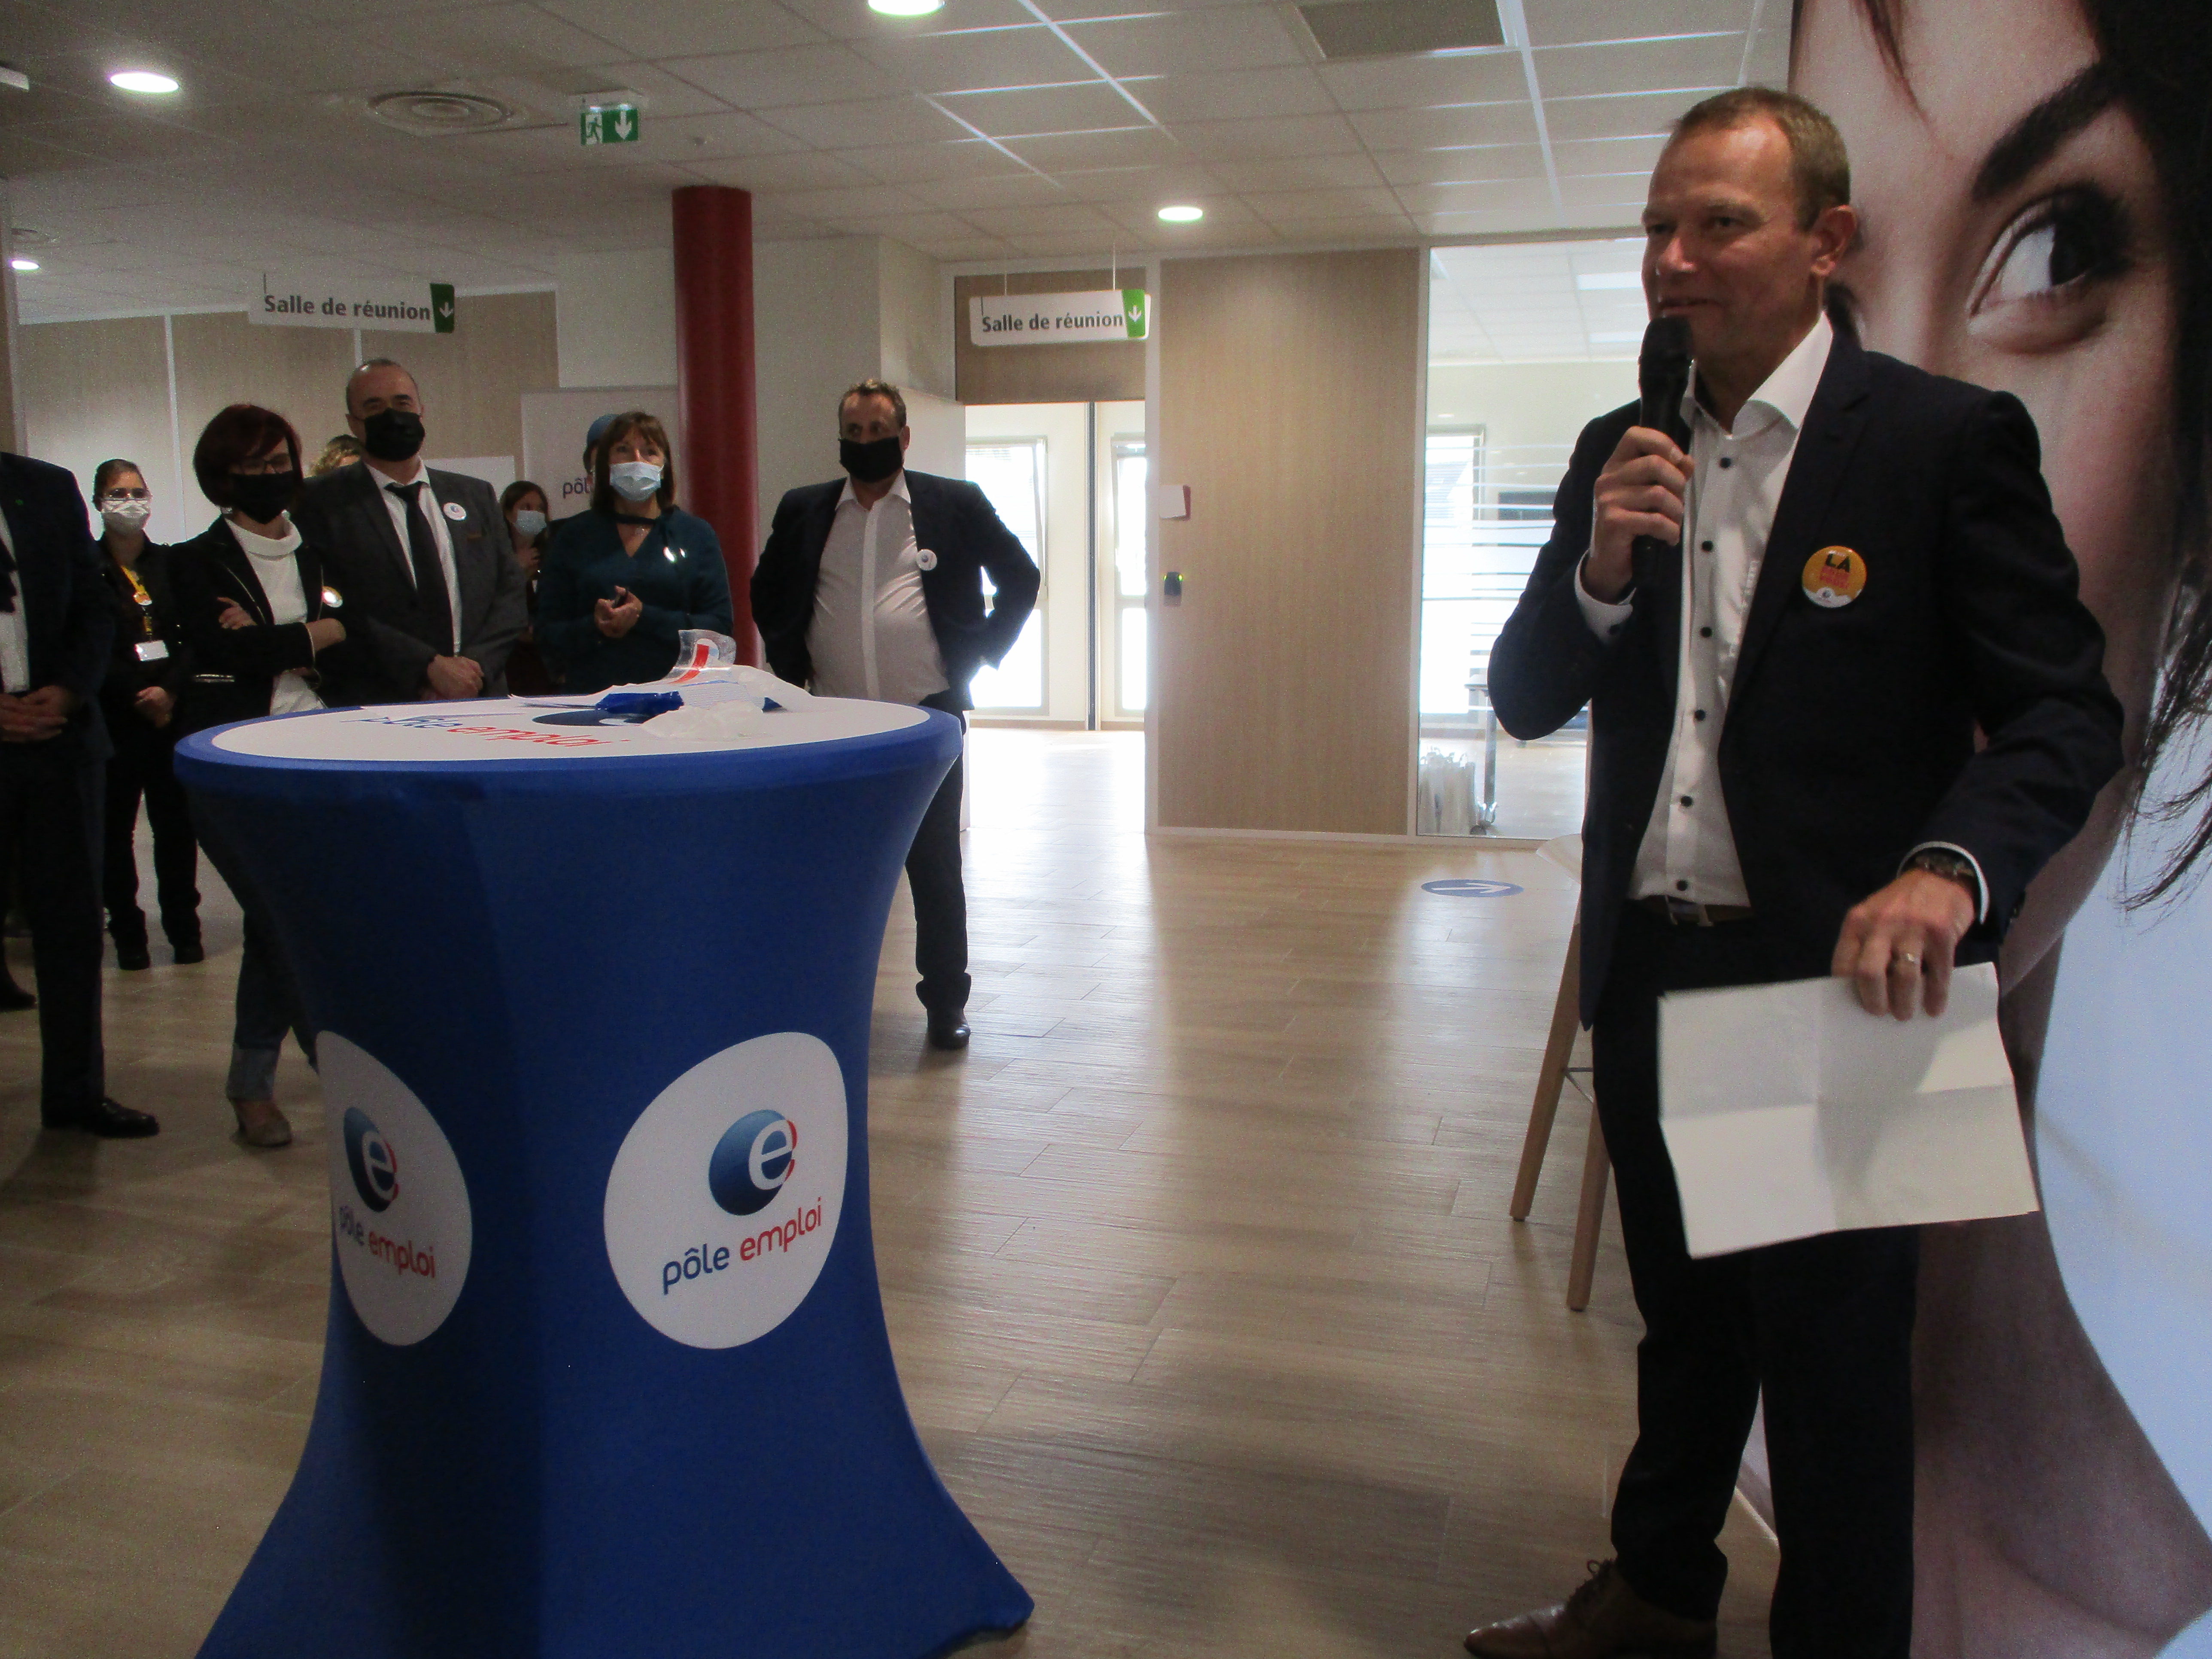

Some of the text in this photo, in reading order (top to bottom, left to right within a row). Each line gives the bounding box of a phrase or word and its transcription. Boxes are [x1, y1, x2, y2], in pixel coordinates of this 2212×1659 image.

[264, 295, 431, 321] Salle de réunion
[981, 311, 1123, 333] Salle de réunion
[1826, 553, 1850, 572] LA
[446, 726, 630, 747] emploi
[368, 1231, 436, 1278] emploi
[662, 1197, 822, 1295] pôle emploi
